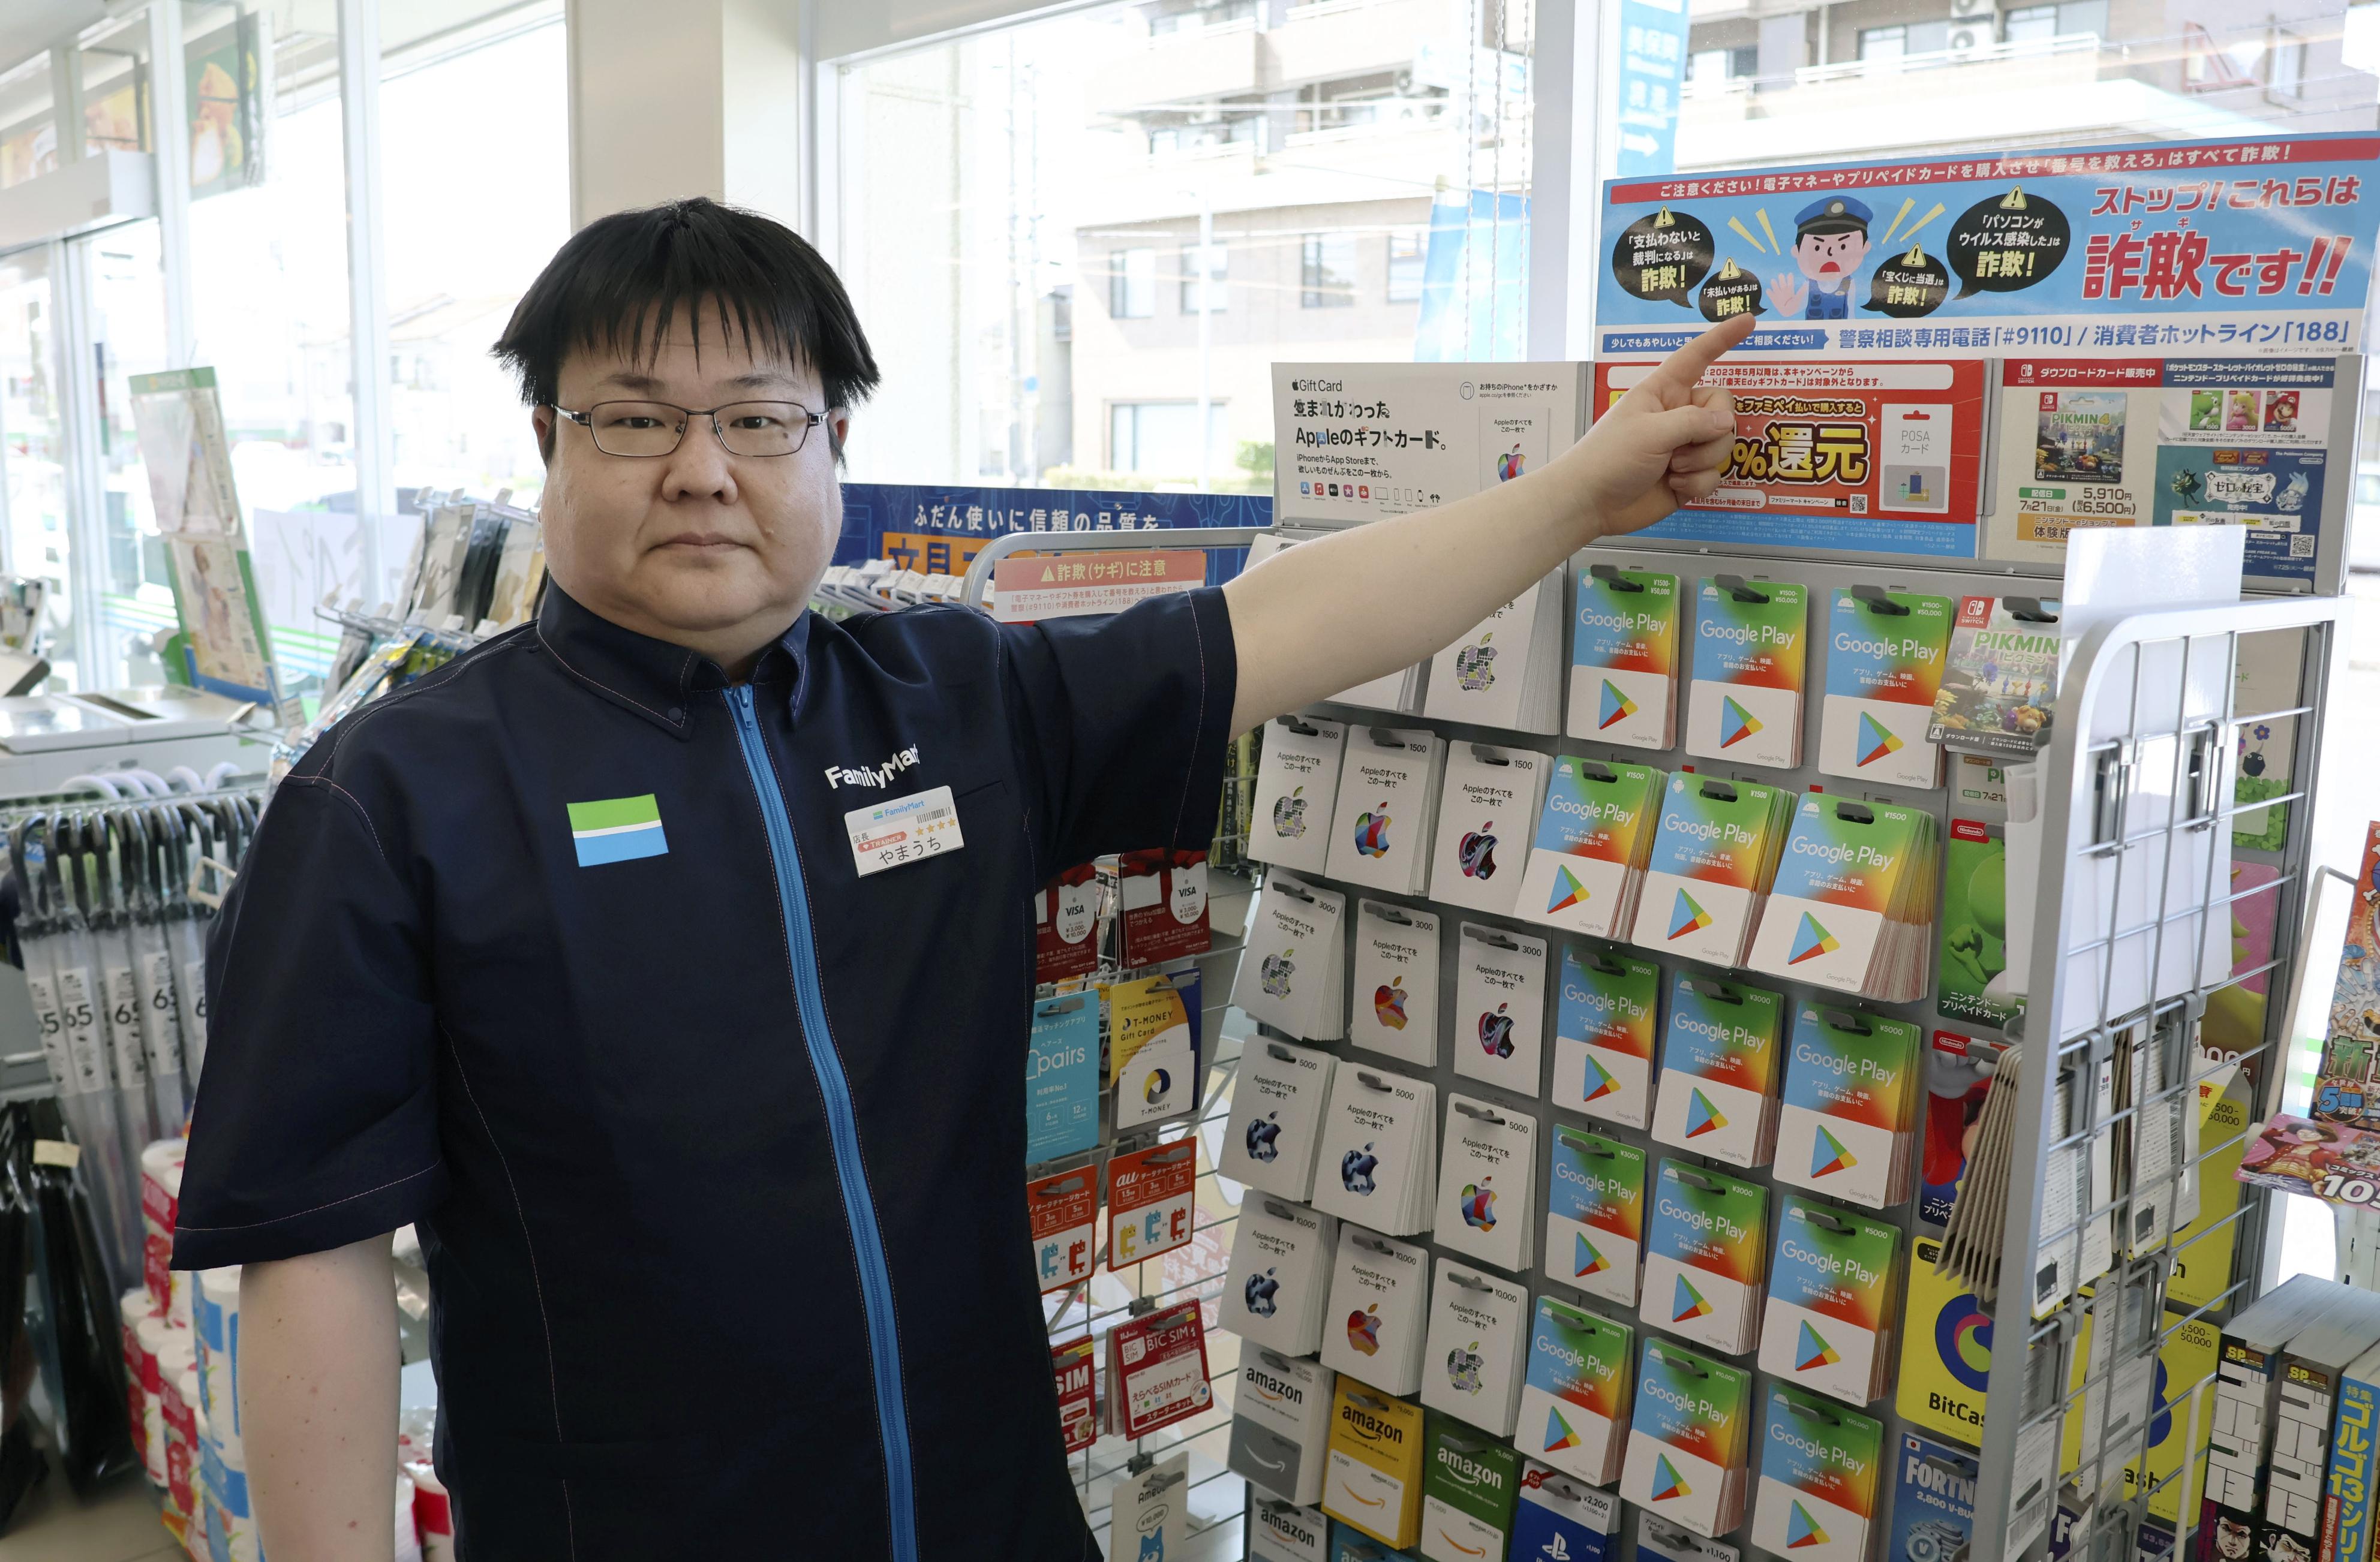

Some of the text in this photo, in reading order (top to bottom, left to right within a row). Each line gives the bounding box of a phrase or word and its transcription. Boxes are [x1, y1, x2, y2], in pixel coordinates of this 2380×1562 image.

[2090, 176, 2361, 215] ストップ!これらは
[1982, 215, 2044, 230] 「パソコンが
[2131, 216, 2189, 230] サ ギ
[1628, 230, 1700, 247] 「支払わないと
[1959, 232, 2060, 248] ウイルス感染した」は
[1633, 249, 1693, 266] 裁判になる」は
[1976, 251, 2033, 278] 詐欺!
[2082, 230, 2354, 300] 詐欺です!!
[1641, 266, 1686, 293] 詐欺!
[1882, 270, 1944, 287] 「宝くじに当選」は
[1703, 282, 1758, 299] 「未払いがある」は
[1888, 286, 1927, 307] 詐欺!
[1717, 295, 1751, 317] 詐欺!
[1840, 324, 2071, 350] 警察相談専用電話「#9110」
[2094, 321, 2349, 347] 消費者ホットライン「188」
[2041, 368, 2156, 378] ダウンロードカード販売中
[1299, 380, 1343, 392] Gift Card
[2052, 413, 2111, 426] PIKMIN 4
[1296, 426, 1447, 451] Appleのギフトカード。
[1901, 431, 1930, 443] POSA
[1901, 443, 1929, 454] カード
[1297, 454, 1379, 466] iPhoneからApp Storeまで、
[1298, 465, 1392, 478] 欲しいものぜんぶをこの一枚から。
[2032, 489, 2053, 498] 配信日
[2083, 487, 2132, 501] 5,910円
[2215, 481, 2265, 493] ゼロの秘宝
[2020, 500, 2064, 513] 7月21日(金)
[2035, 517, 2116, 527] ニンテンドーeショップで
[1057, 559, 1167, 581] 詐欺(サギ)に注意
[1650, 586, 1670, 596] ¥50,000
[1653, 579, 1671, 588] ¥1500-
[1775, 596, 1798, 604] ¥50,000
[1580, 607, 1667, 636] Google Play
[1595, 638, 1648, 651] アプリ、ゲーム、音楽、
[1974, 631, 2061, 655] PIKMIN
[2003, 652, 2046, 664] ピクミン
[1322, 730, 1338, 740] 1500
[1945, 733, 1980, 742] ダウンロード版
[1410, 743, 1427, 754] 1500
[825, 743, 920, 789] FamilyMart
[1277, 751, 1321, 766] Appleのすべてを
[1514, 759, 1533, 771] 1500
[1284, 761, 1312, 774] この一枚で
[1626, 771, 1645, 780] ¥1500
[884, 800, 925, 817] FamilyMart
[1549, 794, 1634, 828] Google Play
[1885, 811, 1907, 821] ¥1500
[852, 832, 870, 844] 店長
[1665, 813, 1757, 848] Google Play
[1958, 827, 1982, 835] Nintendo
[870, 835, 903, 848] TRAINER
[879, 836, 941, 865] やまうち
[1678, 845, 1733, 863] アプリ、ゲーム、音楽、
[1178, 886, 1197, 898] VISA
[1065, 904, 1084, 917] VISA
[1318, 900, 1336, 914] 3000
[1415, 920, 1434, 931] 3000
[1380, 950, 1409, 964] この一枚で
[1522, 944, 1542, 957] 3000
[1749, 994, 1771, 1005] ¥3000
[1949, 991, 2000, 1009] ニンテンドー
[1134, 1010, 1174, 1027] T-MONEY
[1942, 1000, 2006, 1022] プリペイドカード
[1120, 1027, 1155, 1042] Gift Card
[1940, 1039, 1963, 1048] Nintendo
[1037, 1045, 1086, 1078] pairs
[1299, 1058, 1317, 1071] 5000
[1796, 1043, 1896, 1087] Google Play
[1395, 1088, 1414, 1101] 5000
[1141, 1103, 1171, 1116] T-MONEY
[1509, 1121, 1528, 1134] 5000
[1141, 1160, 1191, 1181] データチャージカード
[2329, 1164, 2374, 1179] コミックス
[1116, 1171, 1140, 1188] au
[1036, 1190, 1090, 1212] データチャージカード
[1296, 1216, 1317, 1230] 10,000
[1865, 1226, 1888, 1239] ¥5000
[1395, 1251, 1417, 1266] 10,000
[1495, 1288, 1517, 1304] 10,000
[1457, 1314, 1488, 1331] この一枚で
[1147, 1337, 1167, 1352] BIC
[1170, 1326, 1188, 1343] SIM
[2180, 1332, 2212, 1349] 50,000
[1124, 1343, 1138, 1354] BIC
[2226, 1346, 2246, 1361] SP
[1125, 1352, 1138, 1362] SIM
[2288, 1366, 2309, 1382] SP
[1132, 1371, 1192, 1403] えらべるSIMカード
[1246, 1367, 1303, 1405] amazon
[2346, 1385, 2373, 1403] 特集
[1146, 1398, 1192, 1422] スターターキット
[1342, 1405, 1403, 1444] amazon
[1846, 1416, 1870, 1431] ¥20,000
[1438, 1445, 1502, 1489] amazon
[1916, 1491, 1946, 1510] 2,800
[1261, 1507, 1315, 1548] amazon
